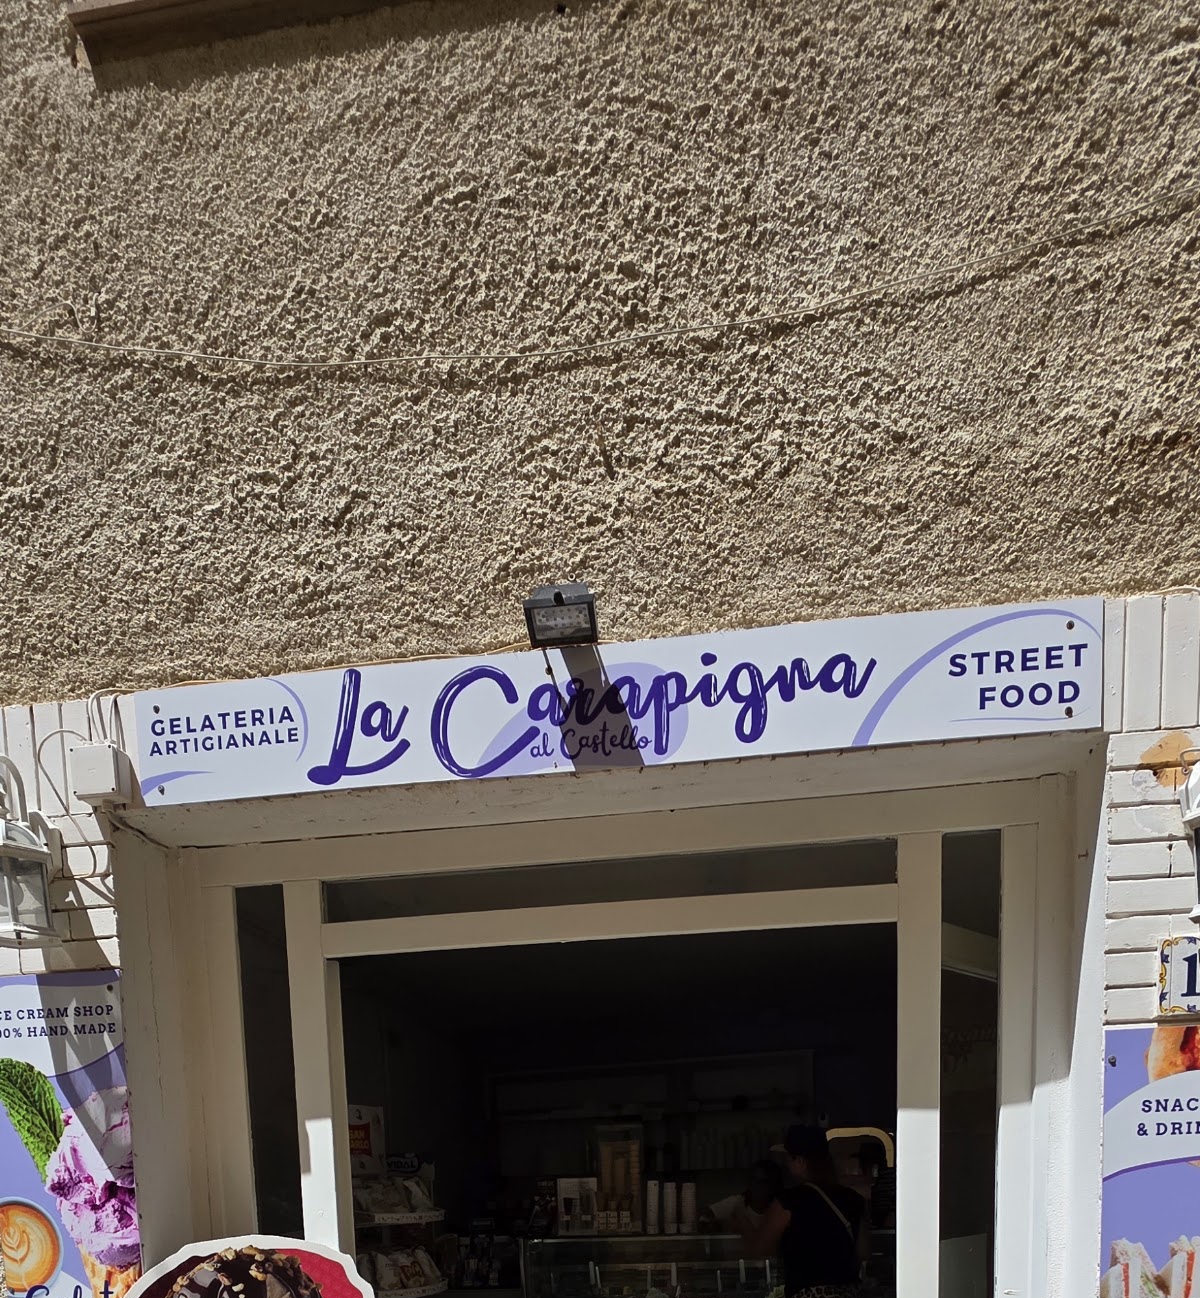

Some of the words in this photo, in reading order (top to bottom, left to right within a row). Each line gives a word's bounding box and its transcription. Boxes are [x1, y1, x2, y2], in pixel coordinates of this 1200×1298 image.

[948, 643, 1088, 677] STREET
[979, 681, 1081, 710] FOOD
[151, 705, 294, 736] GELATERIA
[307, 668, 411, 785] La
[430, 652, 877, 778] Carapigna
[149, 727, 299, 756] ARTIGIANALE
[530, 732, 554, 758] al
[560, 721, 653, 760] Castello
[16, 1007, 69, 1020] CREAM
[74, 1004, 114, 1017] SHOP
[0, 1027, 22, 1039] 0%
[27, 1025, 69, 1038] HAND
[73, 1022, 116, 1035] MADE
[1141, 1098, 1200, 1113] SNAC
[1137, 1123, 1149, 1136] &
[387, 1160, 416, 1169] VIDAL
